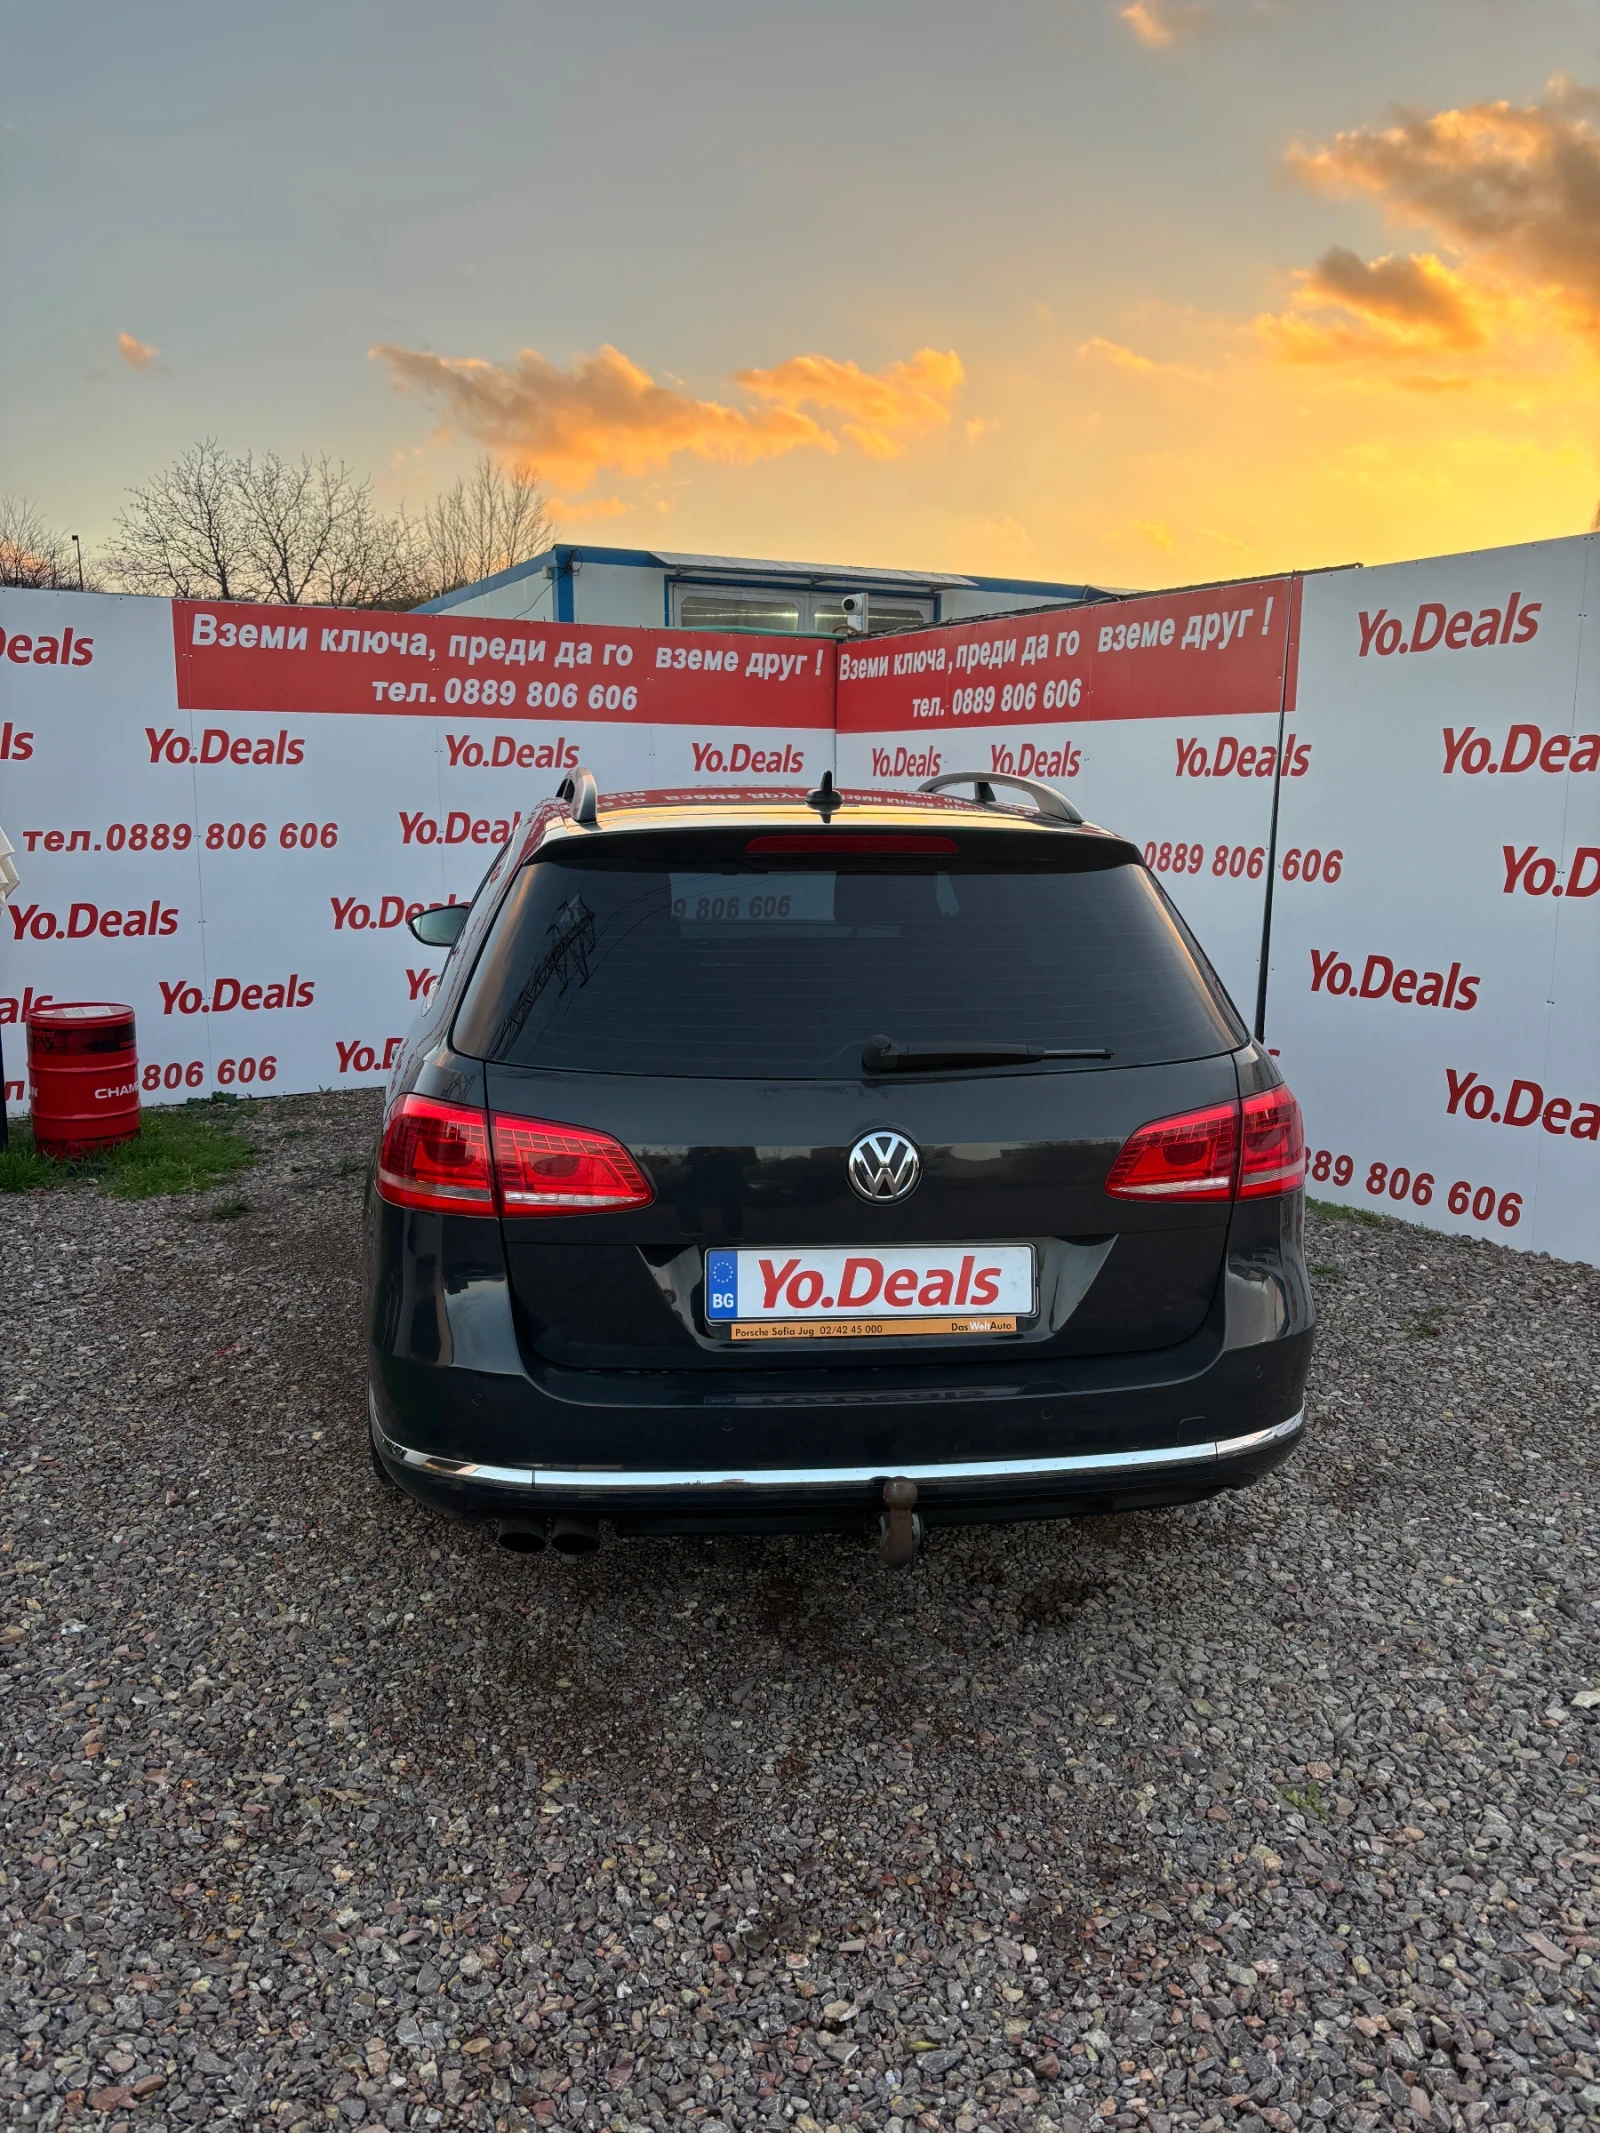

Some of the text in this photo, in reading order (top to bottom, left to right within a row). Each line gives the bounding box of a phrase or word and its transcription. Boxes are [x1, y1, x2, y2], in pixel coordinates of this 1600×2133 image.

[839, 654, 888, 681] Вземи
[956, 640, 1014, 675] преди
[1021, 636, 1048, 666] да
[1056, 629, 1080, 657] го
[1098, 617, 1175, 654] вземе
[1182, 608, 1254, 651] друг
[1358, 592, 1543, 657] Yo.Deals
[0, 626, 94, 666] eals
[192, 613, 308, 650] Вземи
[320, 628, 436, 661] ключа,
[449, 635, 546, 666] преди
[554, 641, 592, 668] да
[603, 643, 634, 667] го
[656, 647, 739, 672] вземе
[745, 652, 808, 681] друг
[372, 678, 638, 711] тел. 0889 806 606
[912, 678, 1082, 718] тел. 0889 806 606
[145, 727, 305, 765] Yo.Deals
[445, 735, 579, 769] Yo.Deals
[692, 742, 804, 773] Yo.Deals
[872, 745, 942, 777] Yo.Deals
[991, 741, 1082, 778] Yo.Deals
[1175, 733, 1312, 777] Yo.Deals
[22, 822, 339, 851] тел.0889 806 606
[1144, 841, 1343, 883] 0889 806 606
[8, 900, 179, 940] Yo.Deals
[696, 897, 741, 920] 806
[749, 895, 792, 919] 606
[158, 974, 315, 1015] Yo.Deals
[1310, 949, 1481, 1011] Yo.Deals
[142, 1055, 278, 1091] 806 606
[1365, 1162, 1435, 1206] 806
[1447, 1180, 1524, 1227] 606
[712, 1293, 735, 1309] BG
[758, 1256, 1002, 1309] Yo.Deals
[735, 1324, 883, 1337] Porsche Sofia Jug 02/42 45 000
